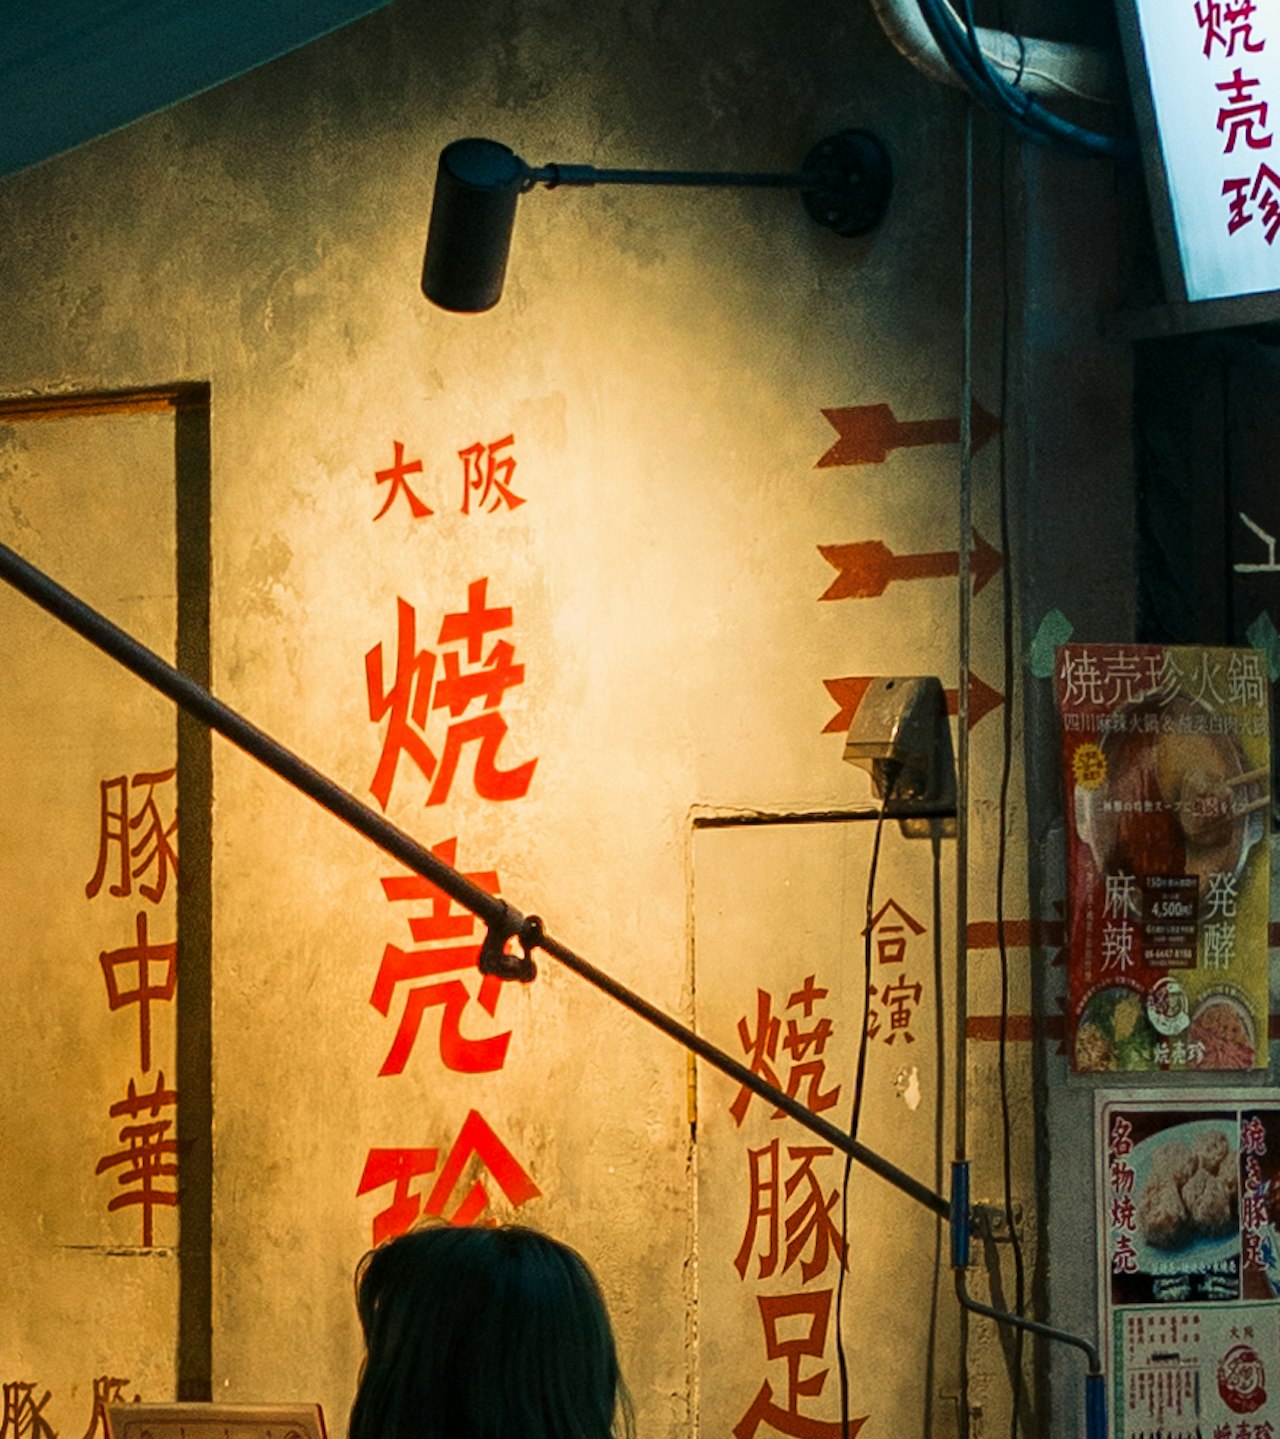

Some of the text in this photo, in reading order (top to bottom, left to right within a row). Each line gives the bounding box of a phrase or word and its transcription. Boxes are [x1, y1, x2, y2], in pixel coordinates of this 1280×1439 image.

[373, 433, 527, 521] 大阪
[1060, 649, 1265, 708] 焼売珍火鍋
[1101, 871, 1142, 972] 麻辣
[1201, 871, 1239, 970] 発酵
[85, 768, 182, 1247] 豚中華
[1111, 1116, 1138, 1274] 名物焼売
[1242, 1116, 1268, 1271] 焼き豚足
